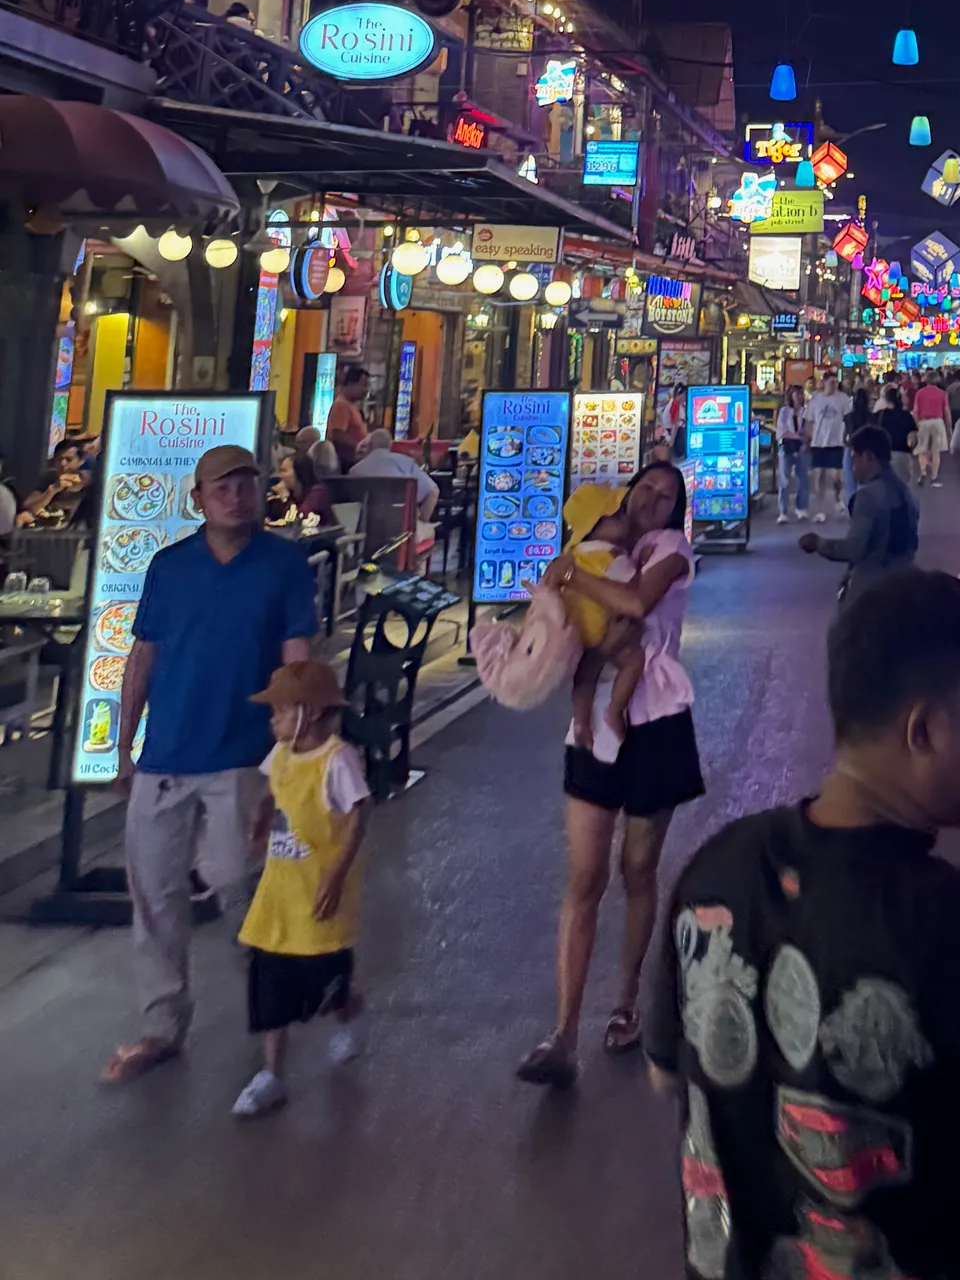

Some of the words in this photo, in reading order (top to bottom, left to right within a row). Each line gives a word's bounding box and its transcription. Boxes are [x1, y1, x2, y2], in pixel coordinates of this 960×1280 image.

[355, 17, 383, 30] The
[320, 22, 415, 52] Rosini
[340, 51, 391, 64] Cuisine
[755, 139, 803, 164] Tiger
[770, 204, 805, 218] ation
[475, 244, 501, 257] easy
[504, 243, 554, 259] speaking
[647, 304, 695, 325] HOTSTONE
[173, 403, 198, 416] The
[502, 399, 551, 415] Rosini
[140, 410, 227, 436] Rosini
[158, 436, 205, 448] Cuisine
[164, 457, 199, 467] AUTHEN
[92, 763, 119, 775] Cock
